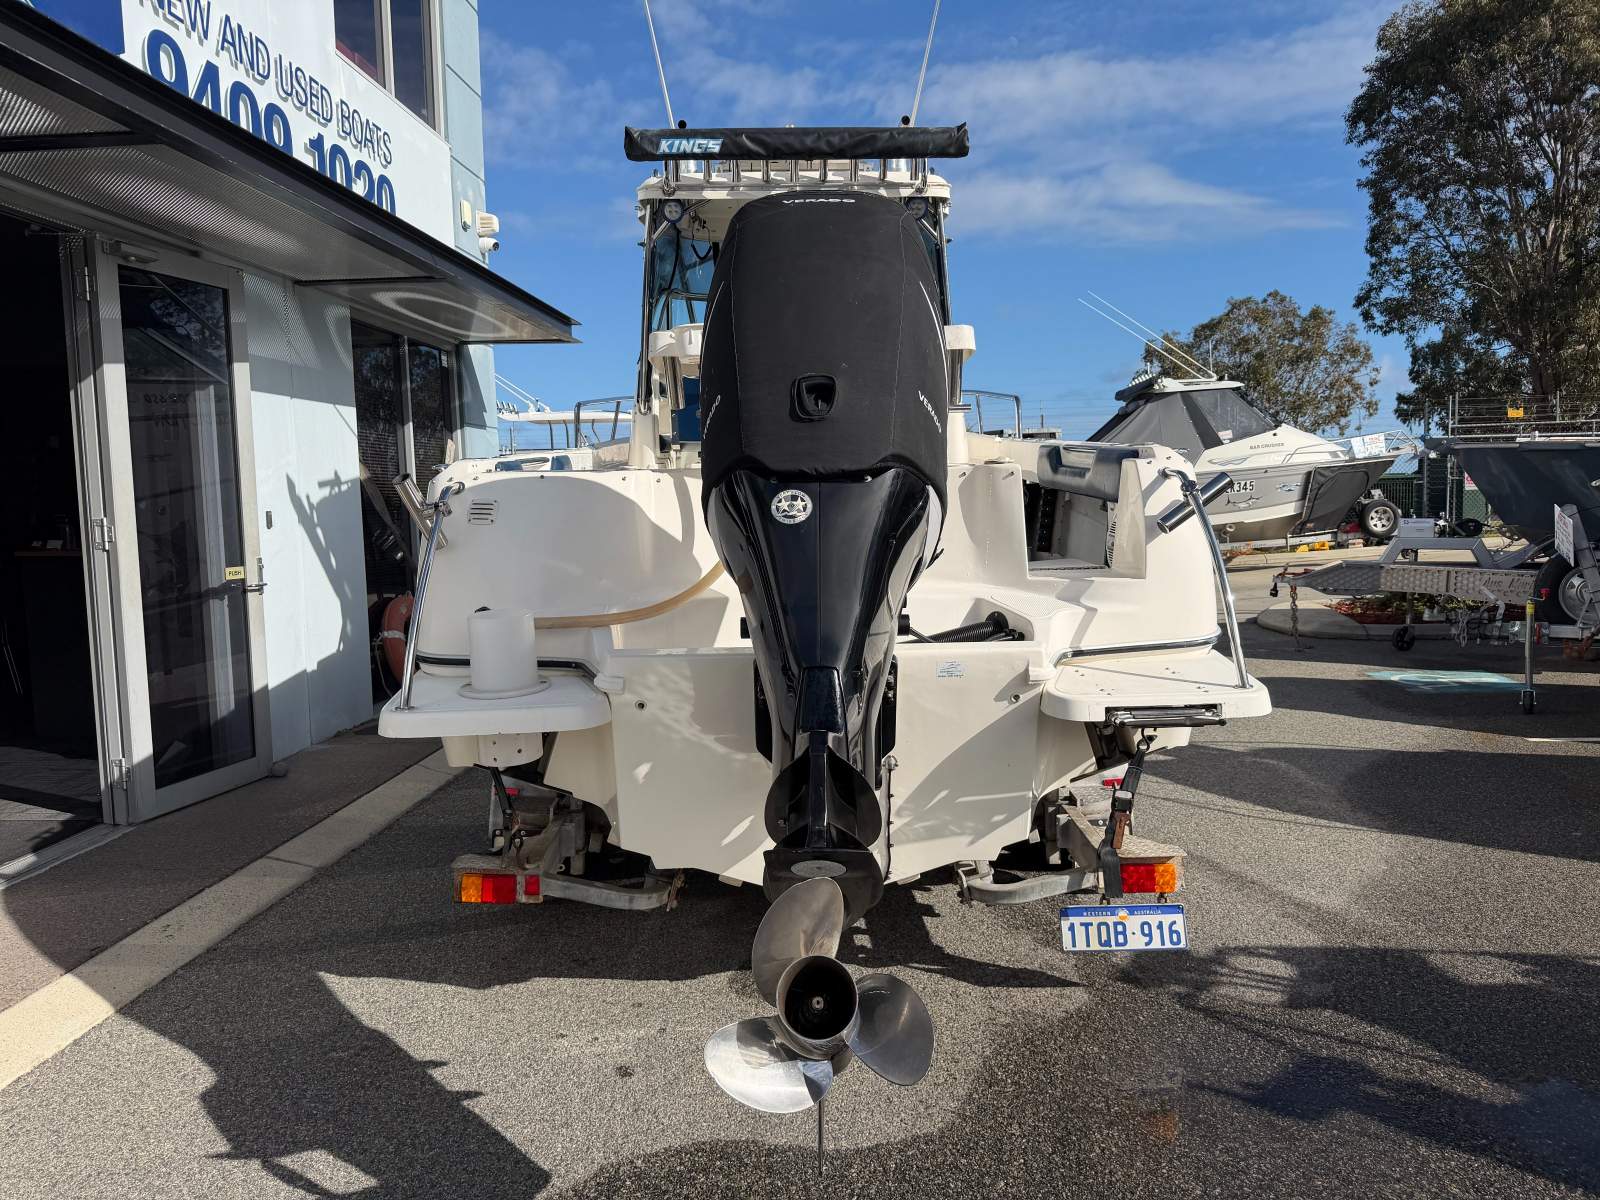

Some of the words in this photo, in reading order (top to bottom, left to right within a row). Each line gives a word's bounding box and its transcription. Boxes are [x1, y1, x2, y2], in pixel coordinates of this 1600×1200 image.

[143, 0, 210, 41] EW
[220, 14, 270, 80] AND
[279, 54, 333, 123] USED
[340, 98, 393, 166] BOATS
[657, 138, 723, 154] KINGS
[1226, 480, 1255, 493] K345
